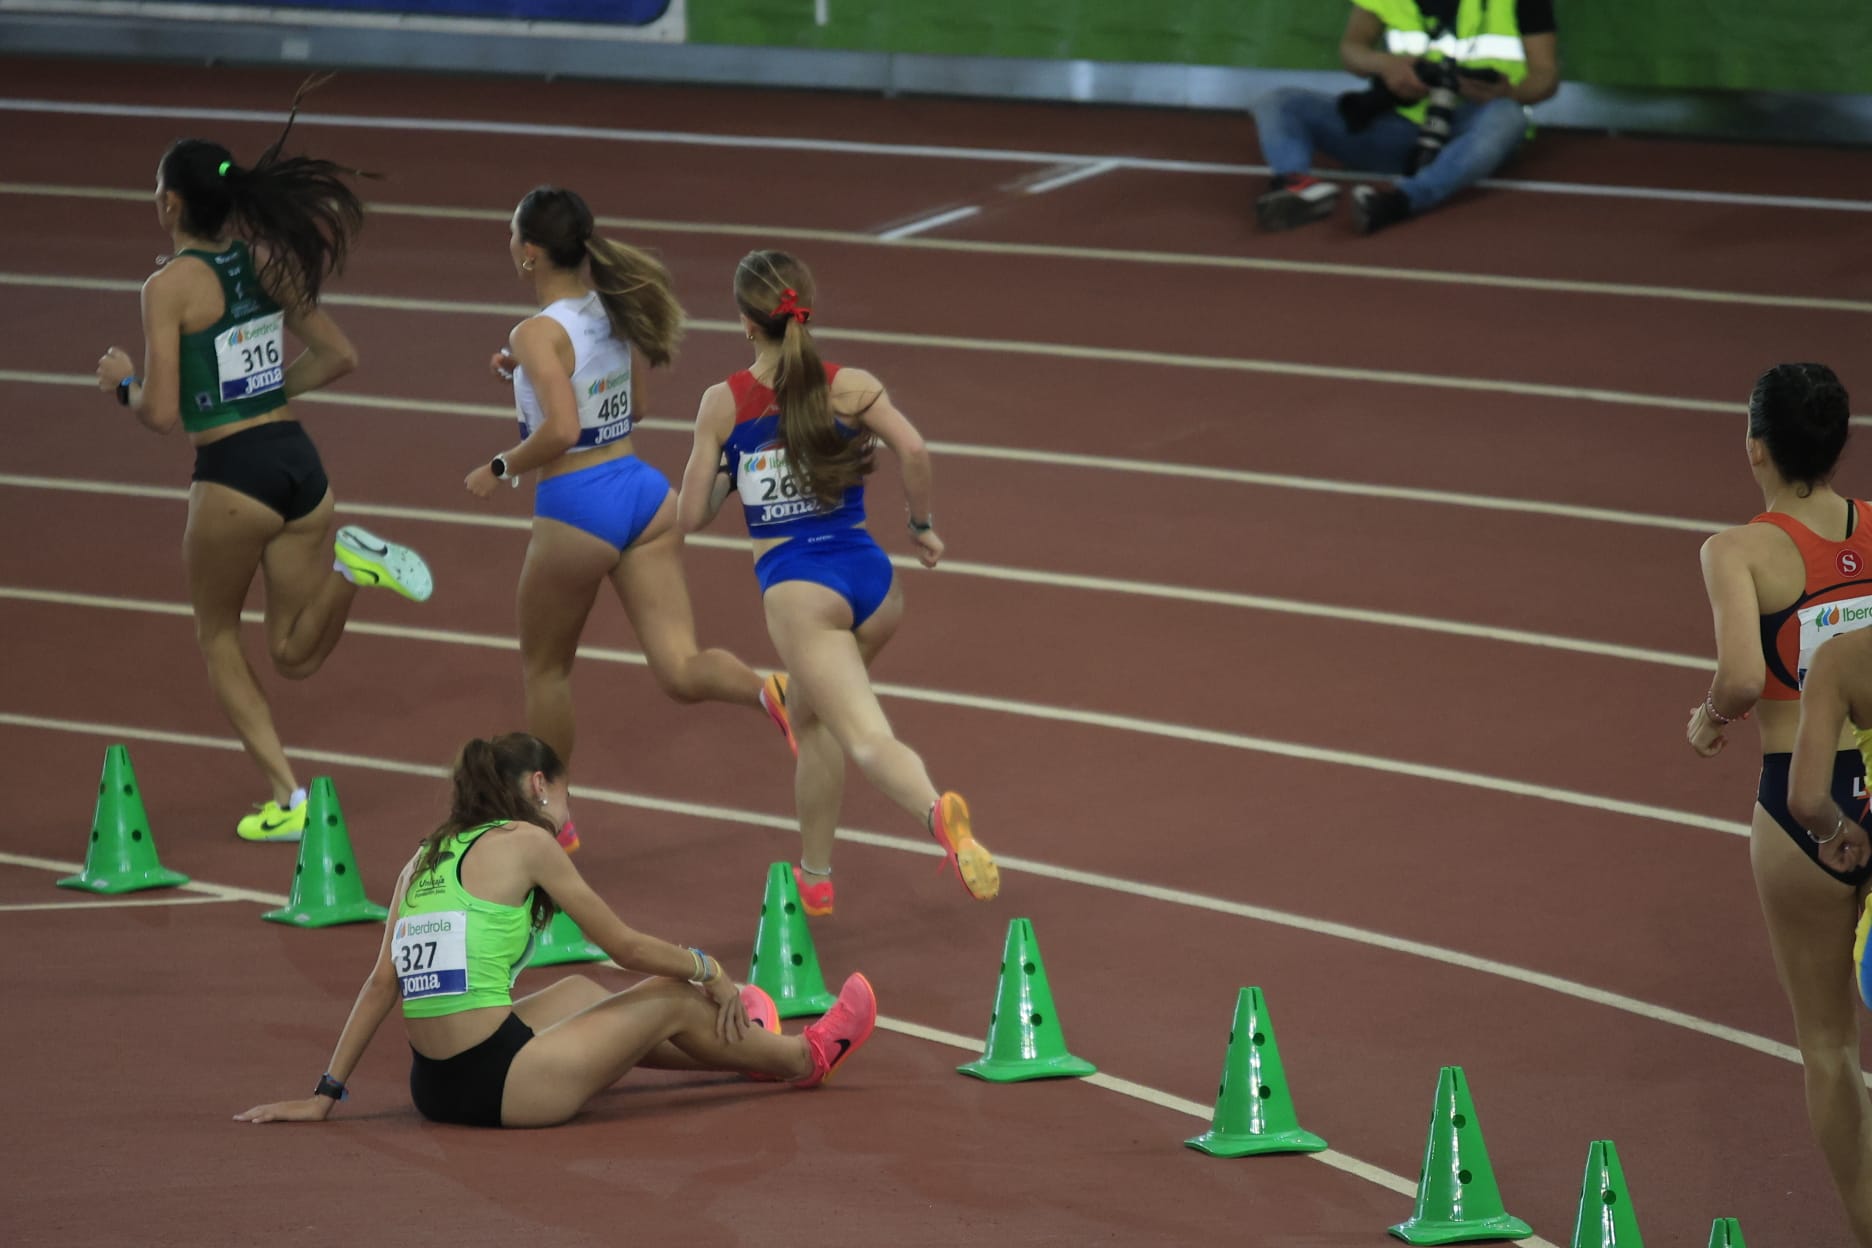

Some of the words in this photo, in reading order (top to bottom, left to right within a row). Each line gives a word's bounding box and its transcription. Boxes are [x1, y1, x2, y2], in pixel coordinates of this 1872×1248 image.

[241, 340, 279, 373] 316
[598, 391, 628, 421] 469
[595, 418, 630, 444] Joma
[1842, 554, 1857, 573] S
[408, 920, 451, 936] Iberdrola
[401, 941, 437, 973] 327
[402, 973, 441, 997] Joma
